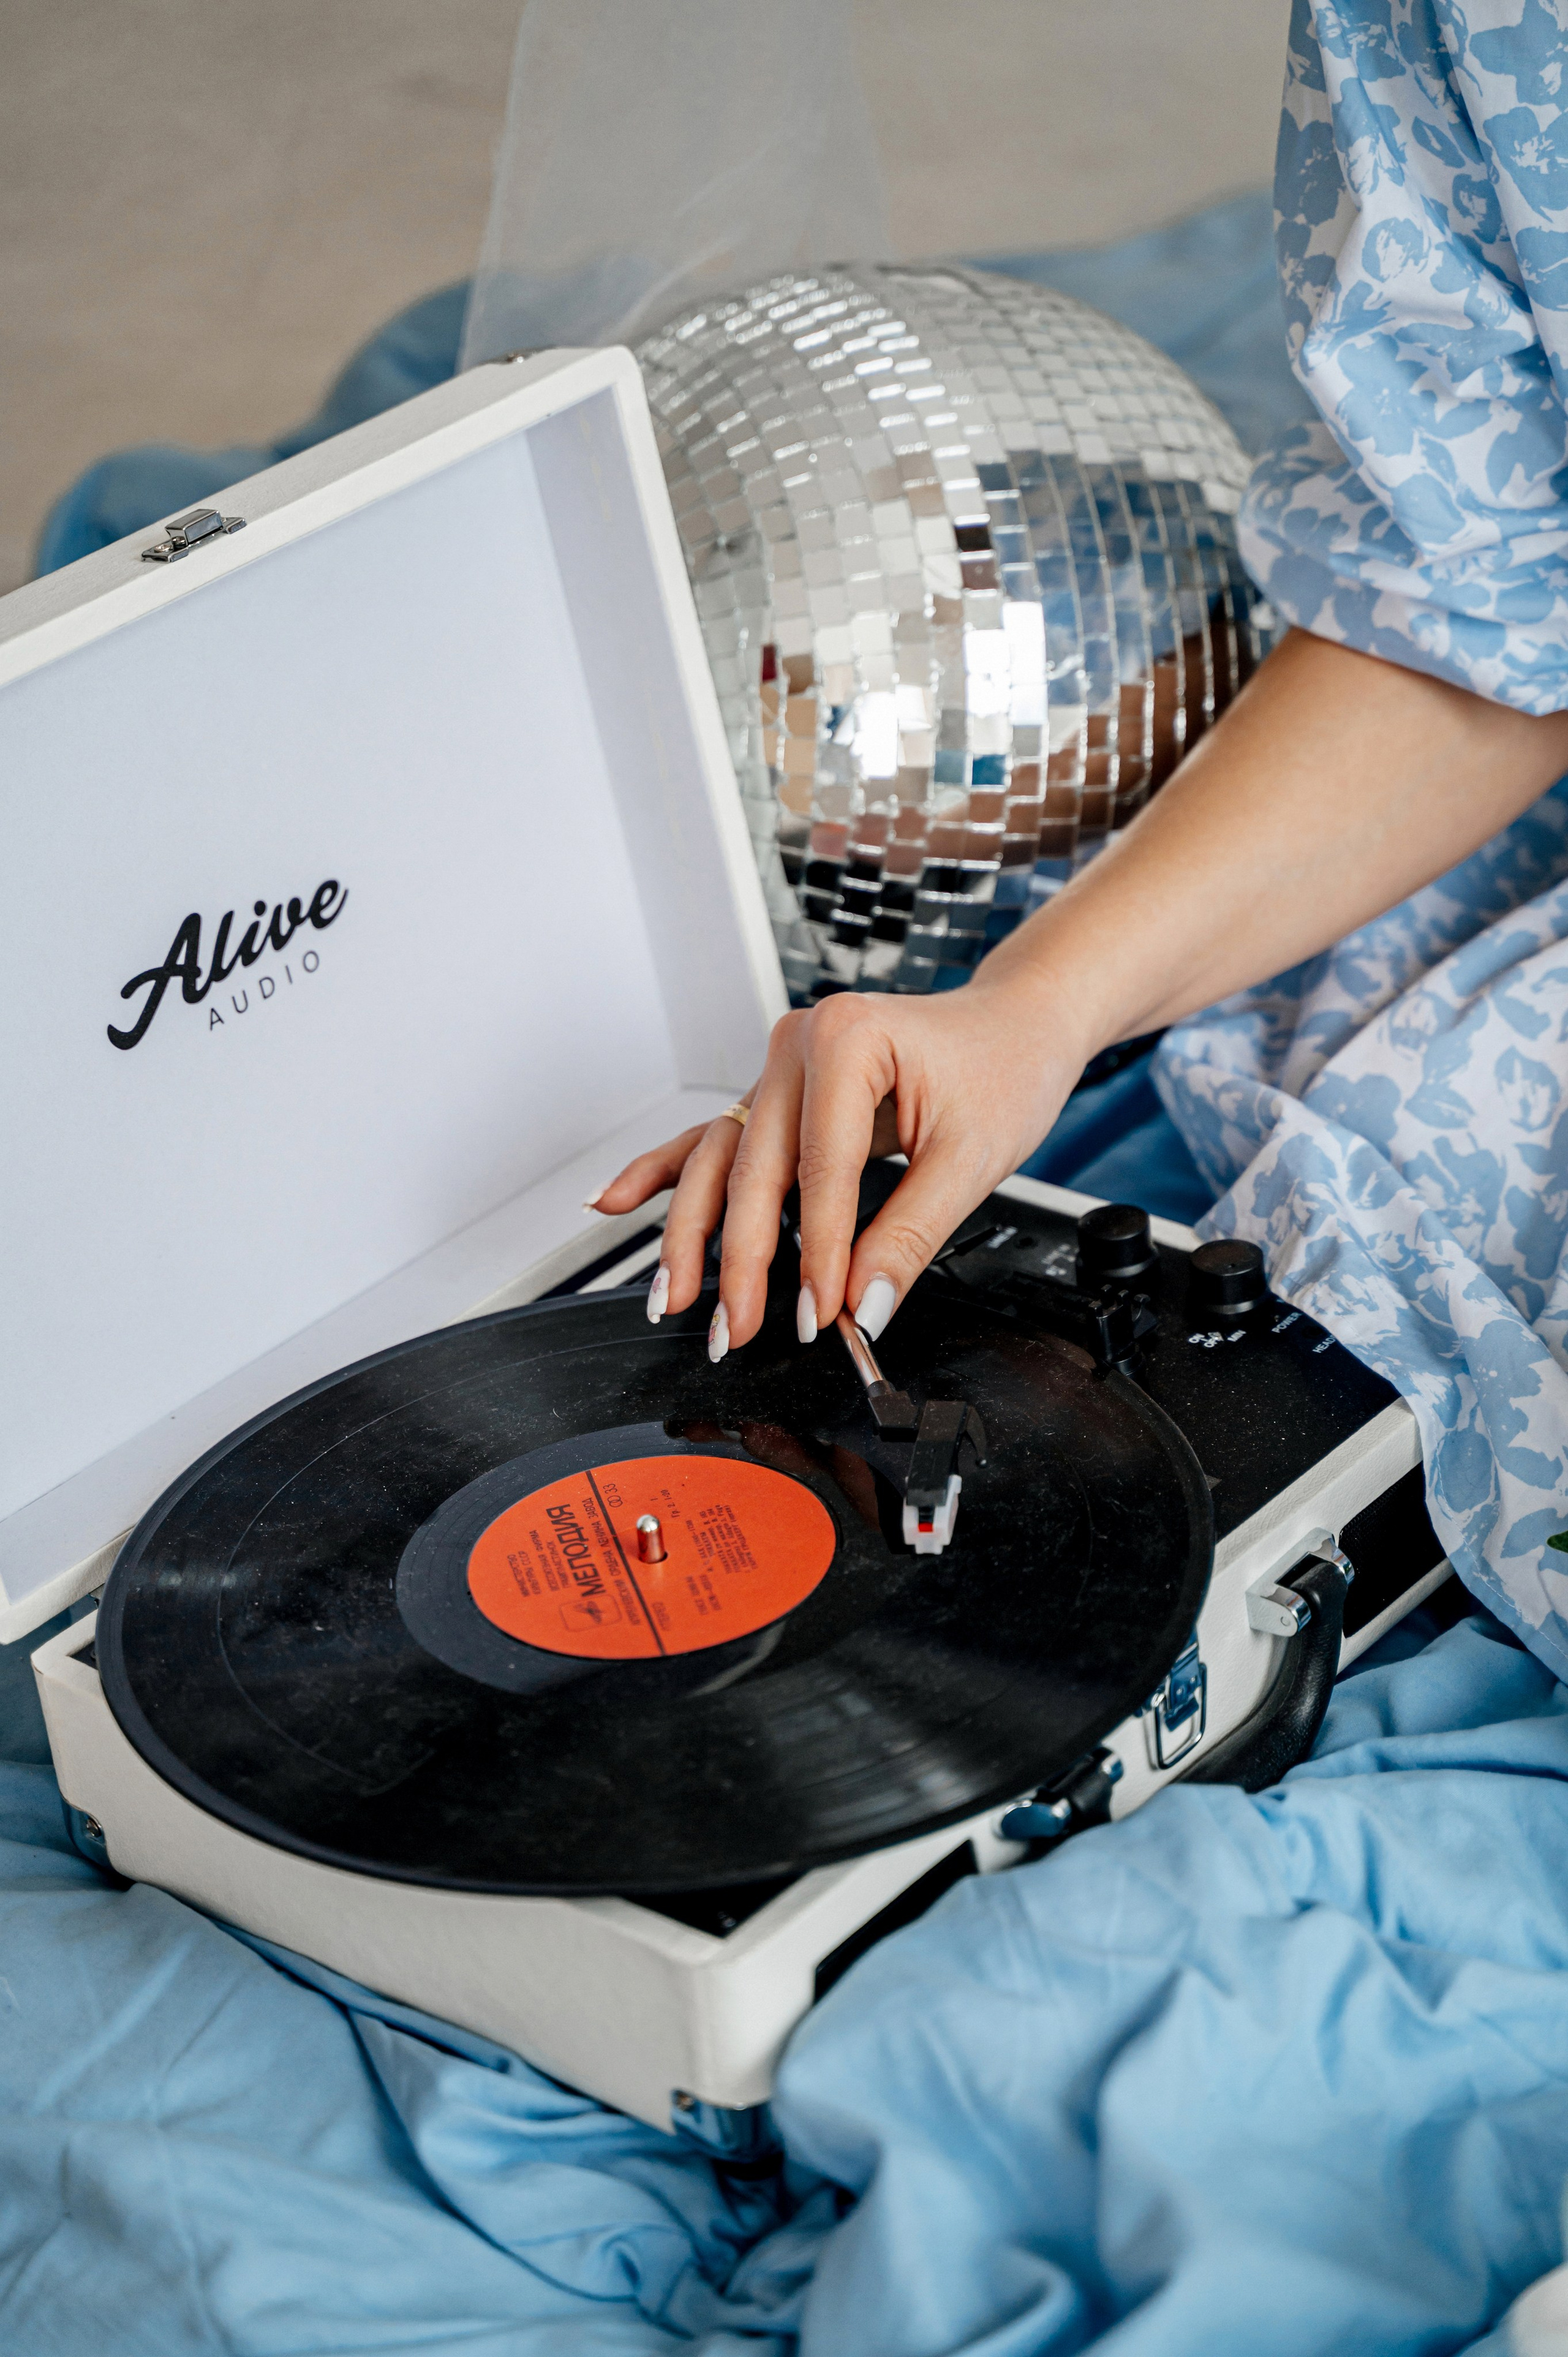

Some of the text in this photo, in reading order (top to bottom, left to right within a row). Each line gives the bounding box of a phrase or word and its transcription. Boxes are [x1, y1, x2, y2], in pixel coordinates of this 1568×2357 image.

[107, 878, 349, 1050] Alive
[209, 949, 320, 1031] AUDIO
[1271, 1311, 1302, 1333] POWER
[1188, 1333, 1205, 1344] ON
[1227, 1329, 1247, 1343] MIN
[1312, 1334, 1336, 1354] HEAD
[602, 1482, 618, 1494] 33
[581, 1496, 599, 1519] ЗАВОД
[529, 1529, 544, 1552] ФИРМА
[590, 1520, 611, 1547] ЛЕНИНА
[517, 1550, 531, 1566] СССР
[545, 1503, 606, 1597] МЕЛОДИЯ
[602, 1548, 621, 1576] ОРДЕНА
